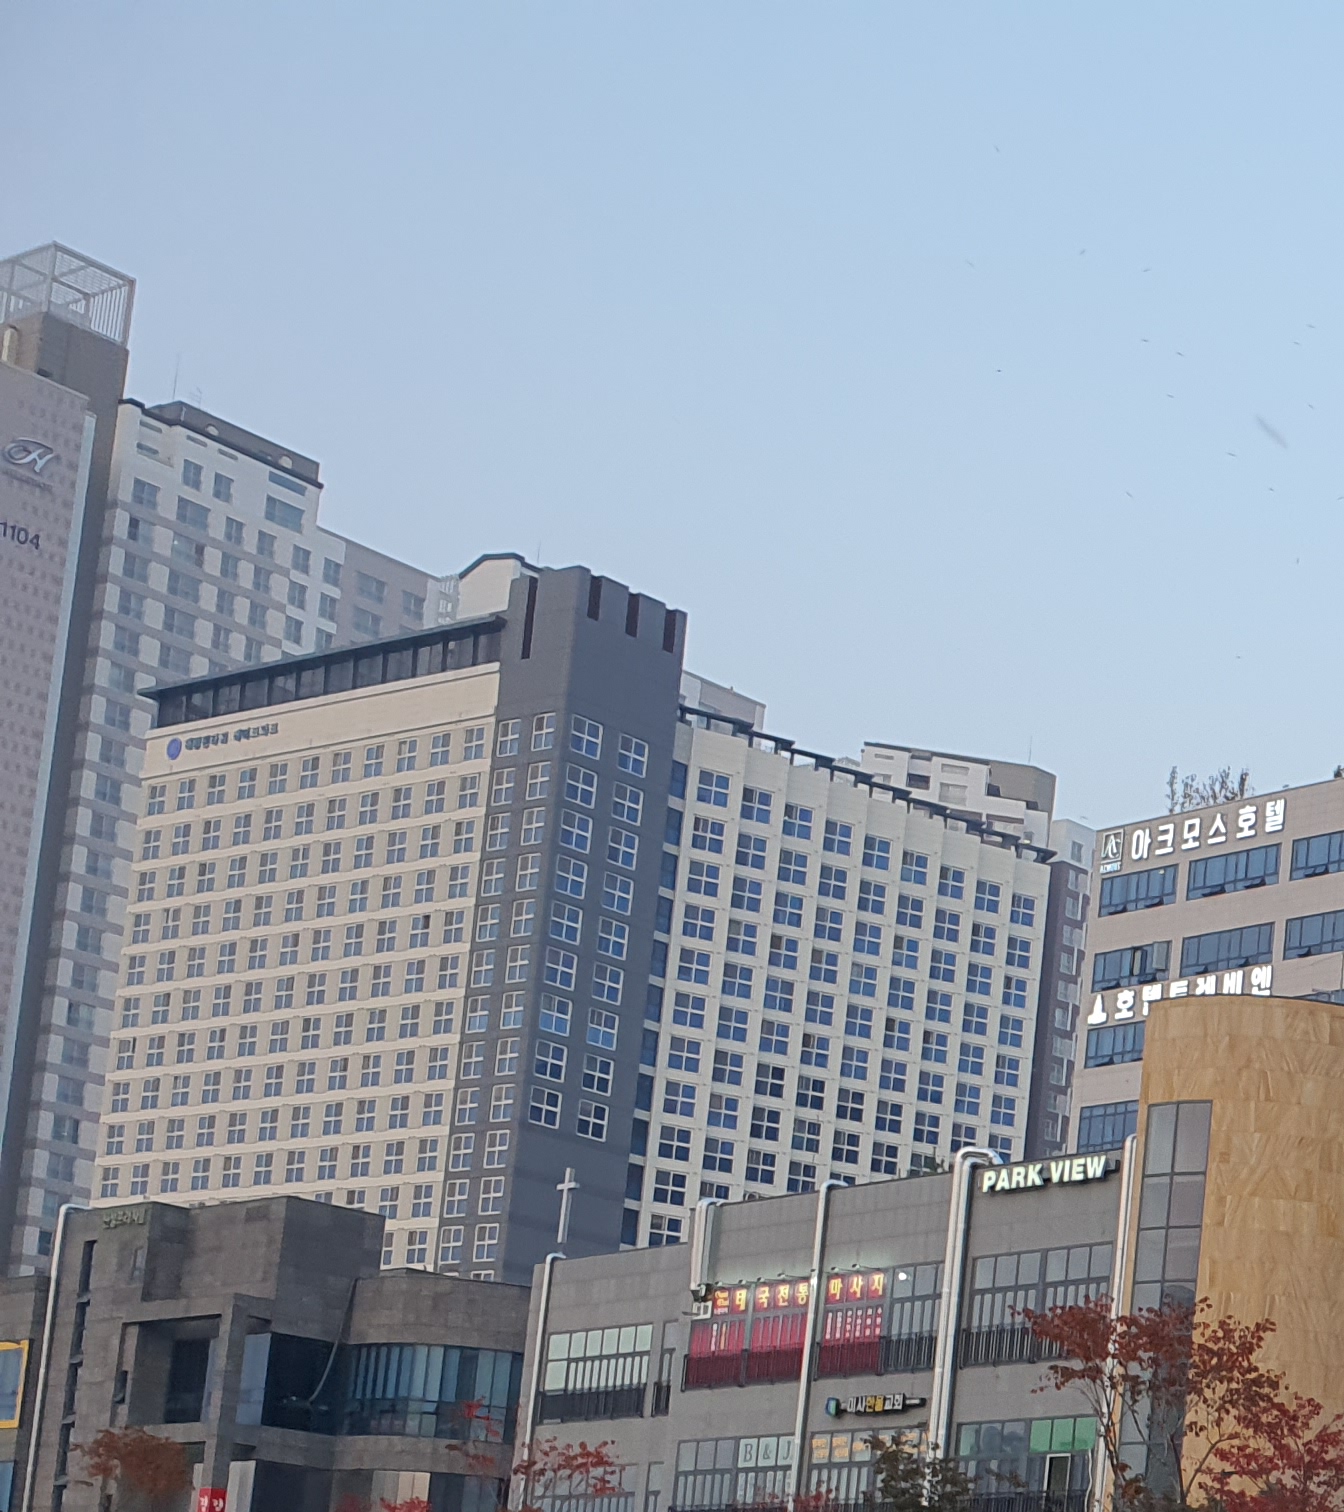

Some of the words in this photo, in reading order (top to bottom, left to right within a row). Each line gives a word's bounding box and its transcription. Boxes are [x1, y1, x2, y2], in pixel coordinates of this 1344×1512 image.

[1131, 798, 1286, 861] 아크모스호텔
[982, 1163, 1045, 1193] PARK
[1050, 1155, 1106, 1184] VIEW
[733, 1282, 809, 1312] 태국전통
[829, 1272, 885, 1301] 마사지
